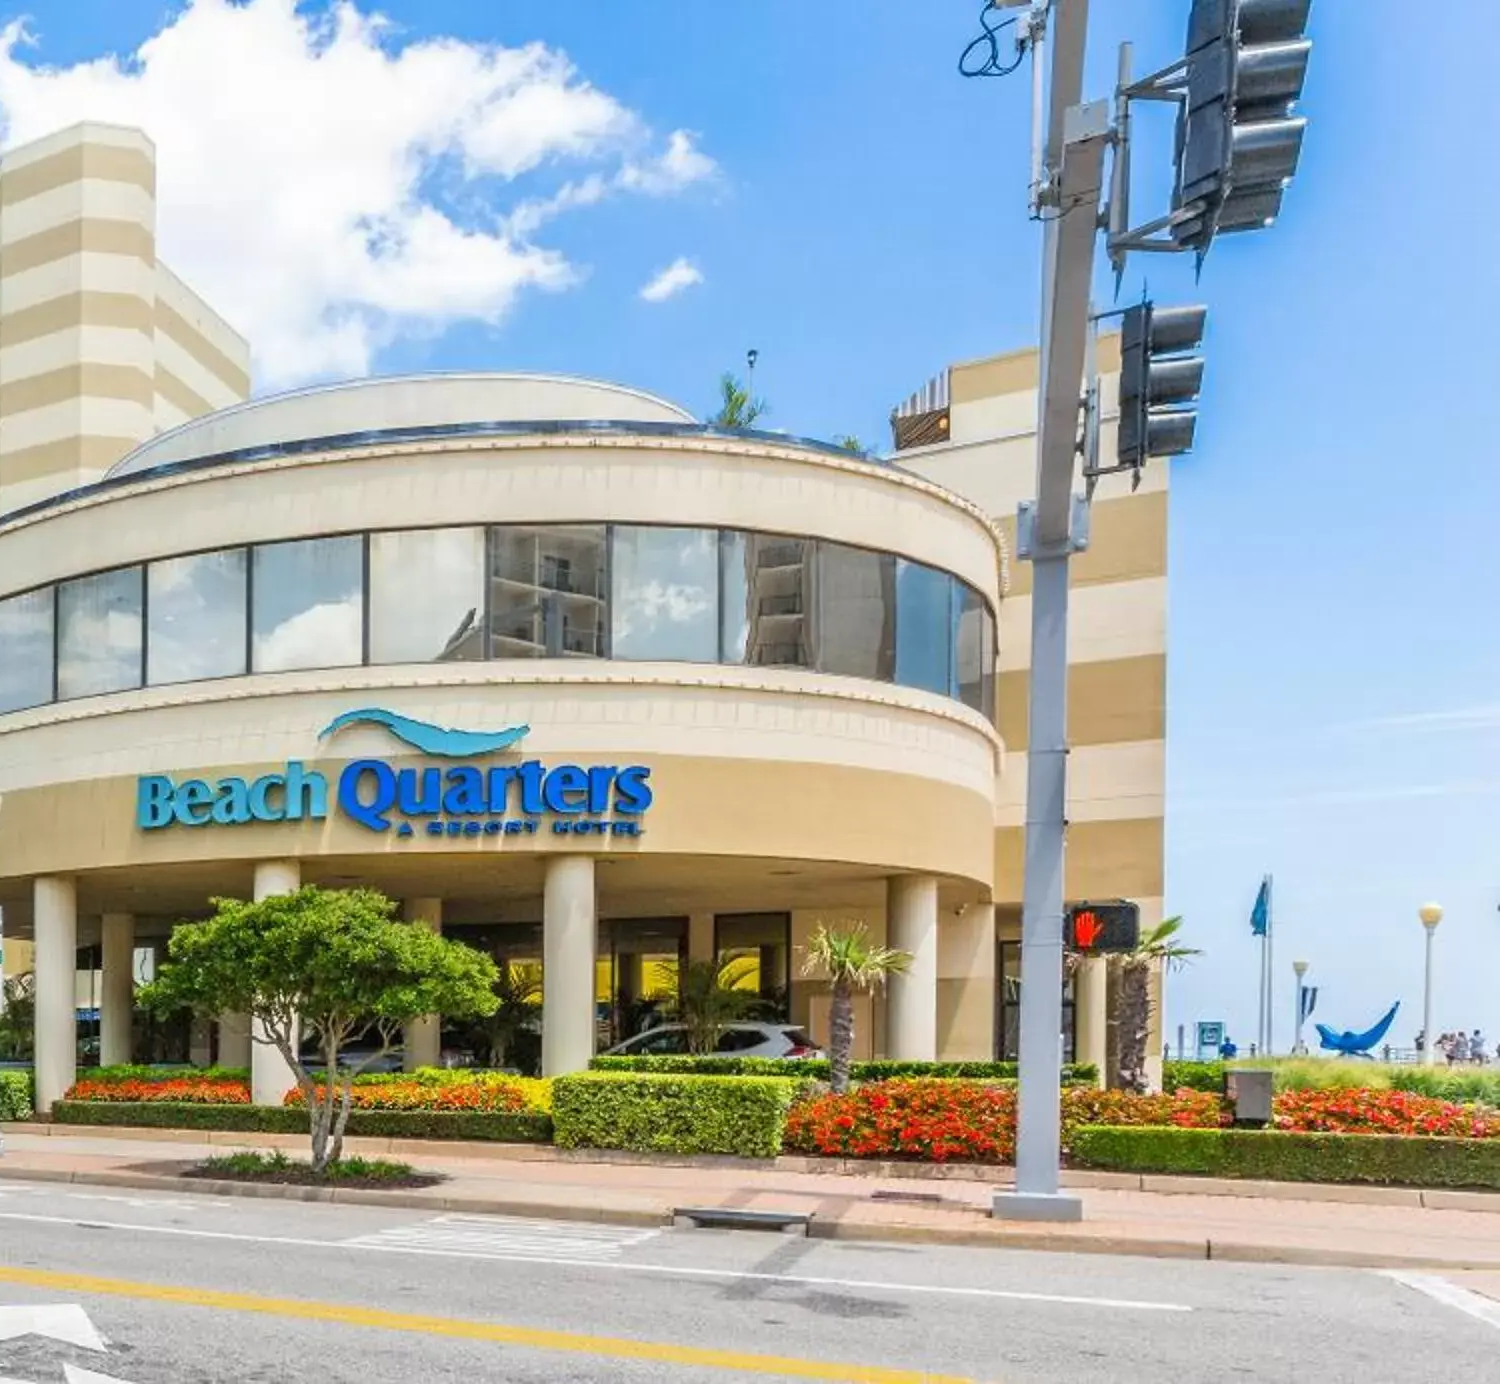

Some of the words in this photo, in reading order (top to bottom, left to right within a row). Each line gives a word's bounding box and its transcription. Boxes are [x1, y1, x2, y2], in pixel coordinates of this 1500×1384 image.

[136, 759, 328, 830] Beach
[339, 758, 653, 831] Quarters
[426, 820, 540, 837] RESORT
[553, 820, 646, 836] HOTEL
